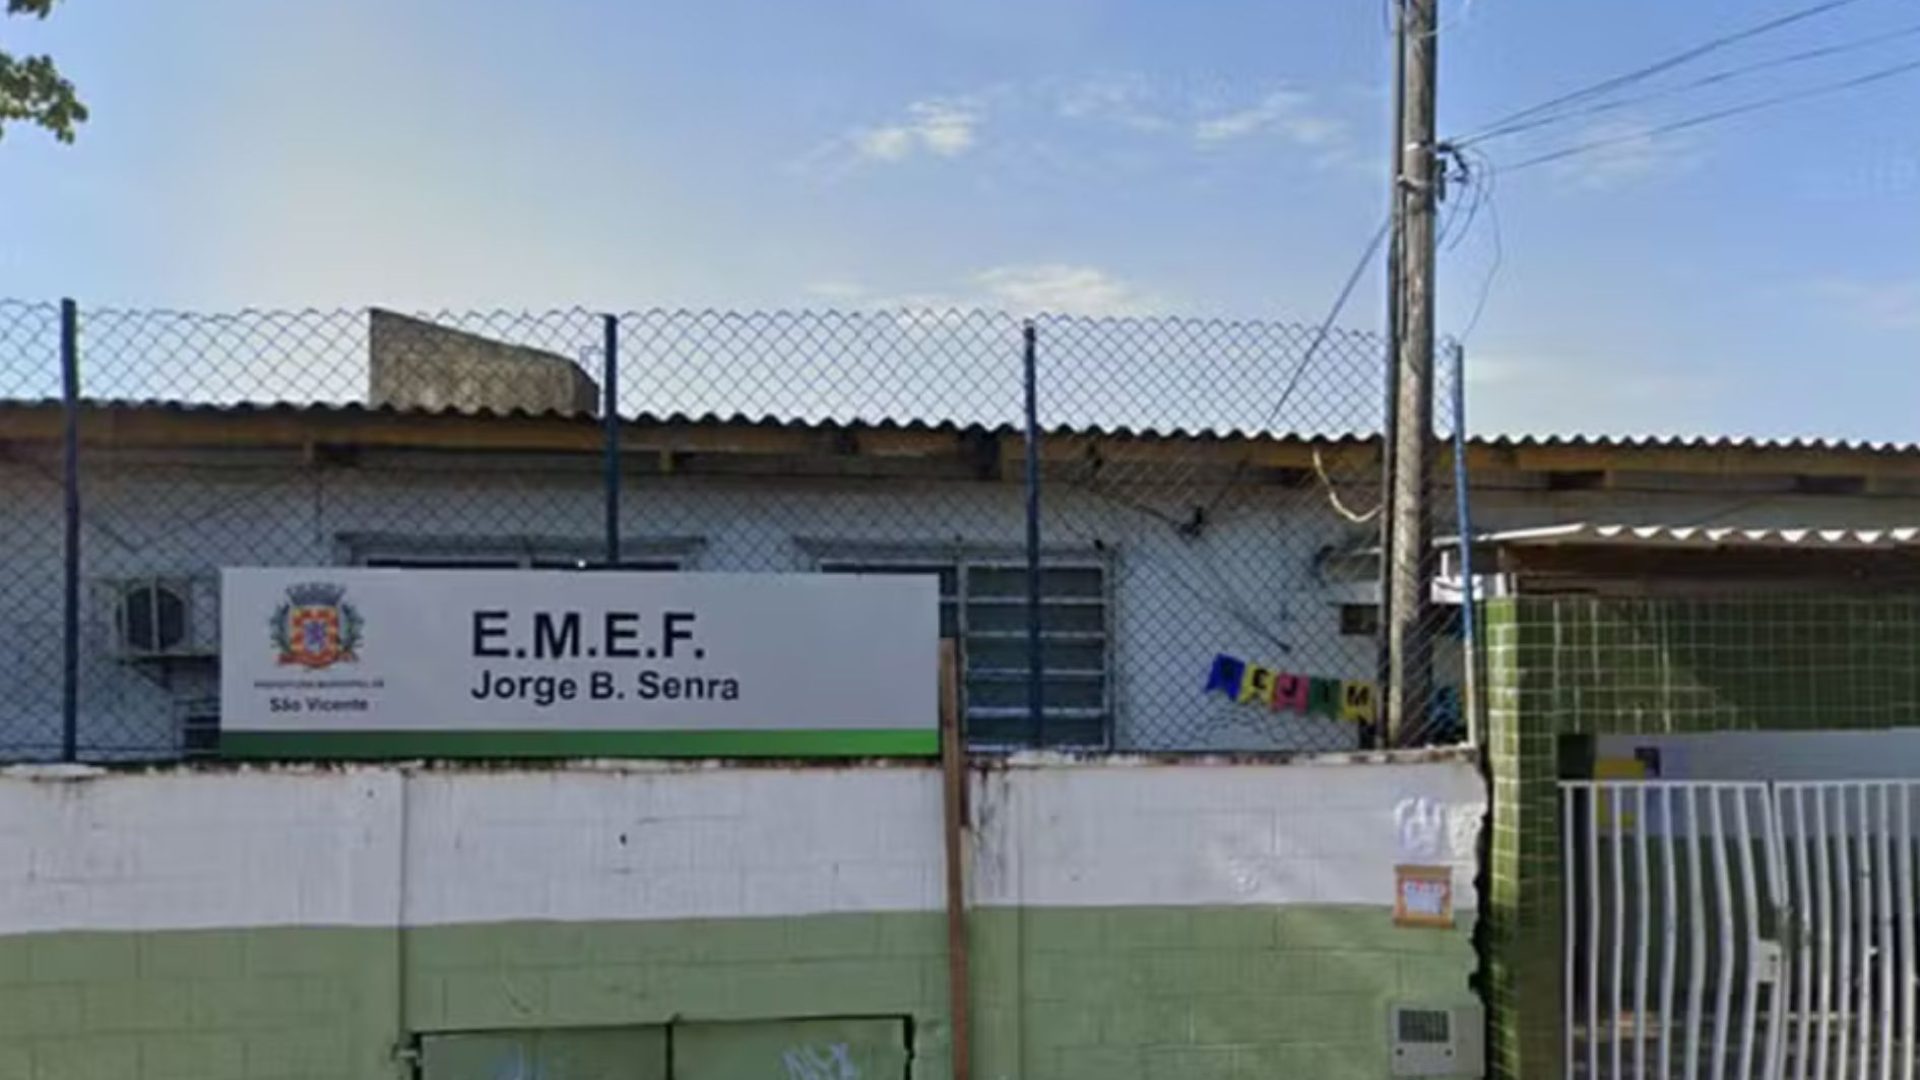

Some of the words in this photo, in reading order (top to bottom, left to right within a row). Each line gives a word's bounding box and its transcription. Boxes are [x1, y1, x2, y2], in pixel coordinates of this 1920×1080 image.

[472, 610, 706, 660] E.M.E.F.
[470, 669, 578, 707] Jorge
[589, 670, 626, 701] B.
[636, 669, 740, 701] Senra
